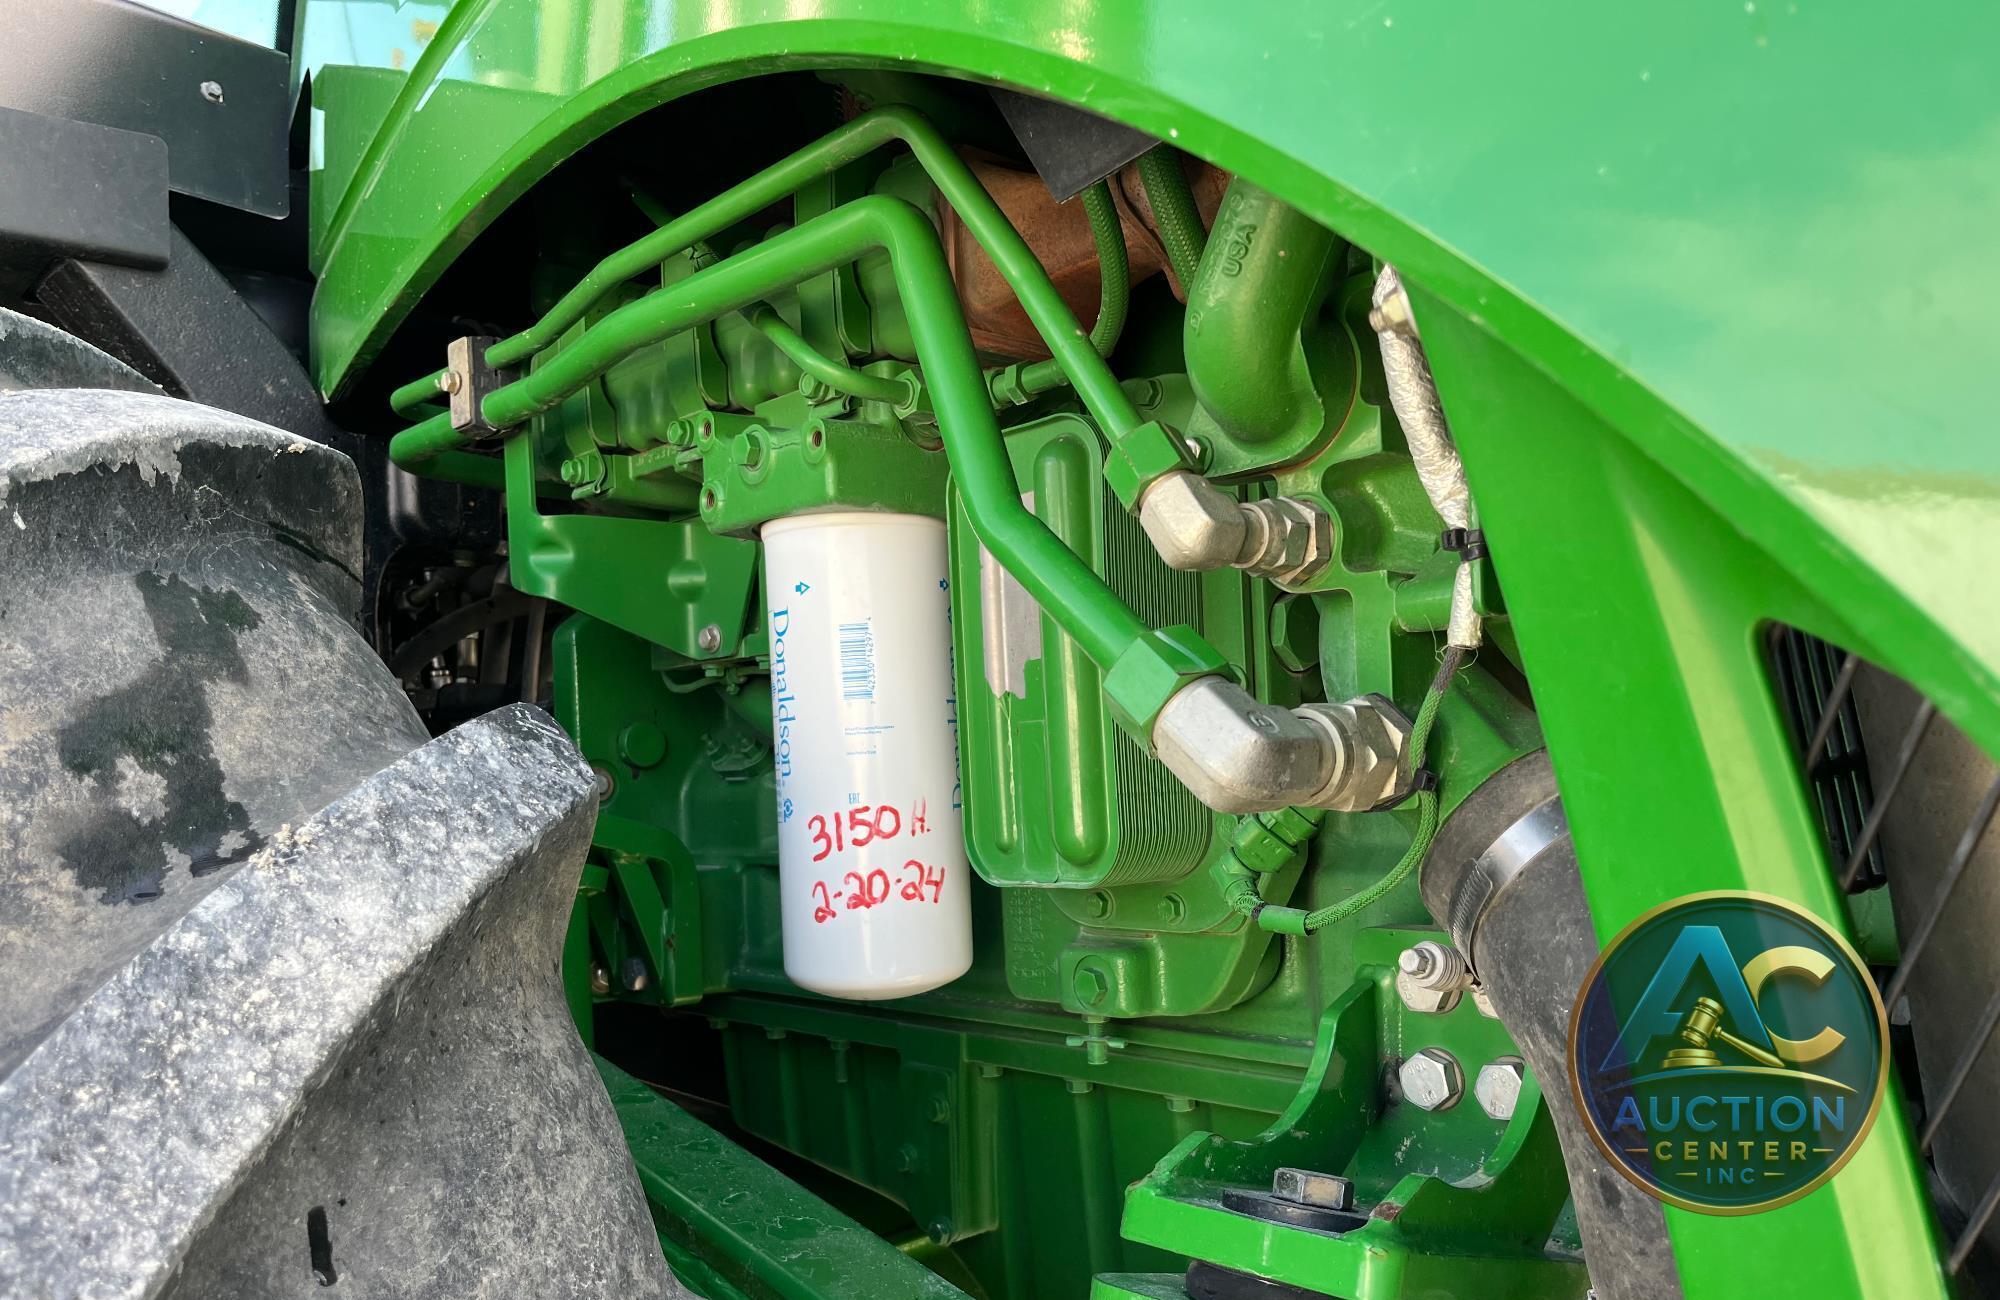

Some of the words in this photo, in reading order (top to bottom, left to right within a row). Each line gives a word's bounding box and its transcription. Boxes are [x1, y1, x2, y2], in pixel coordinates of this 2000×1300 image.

[1222, 223, 1257, 278] USA
[774, 606, 796, 777] Donaldson
[807, 805, 901, 862] 3150
